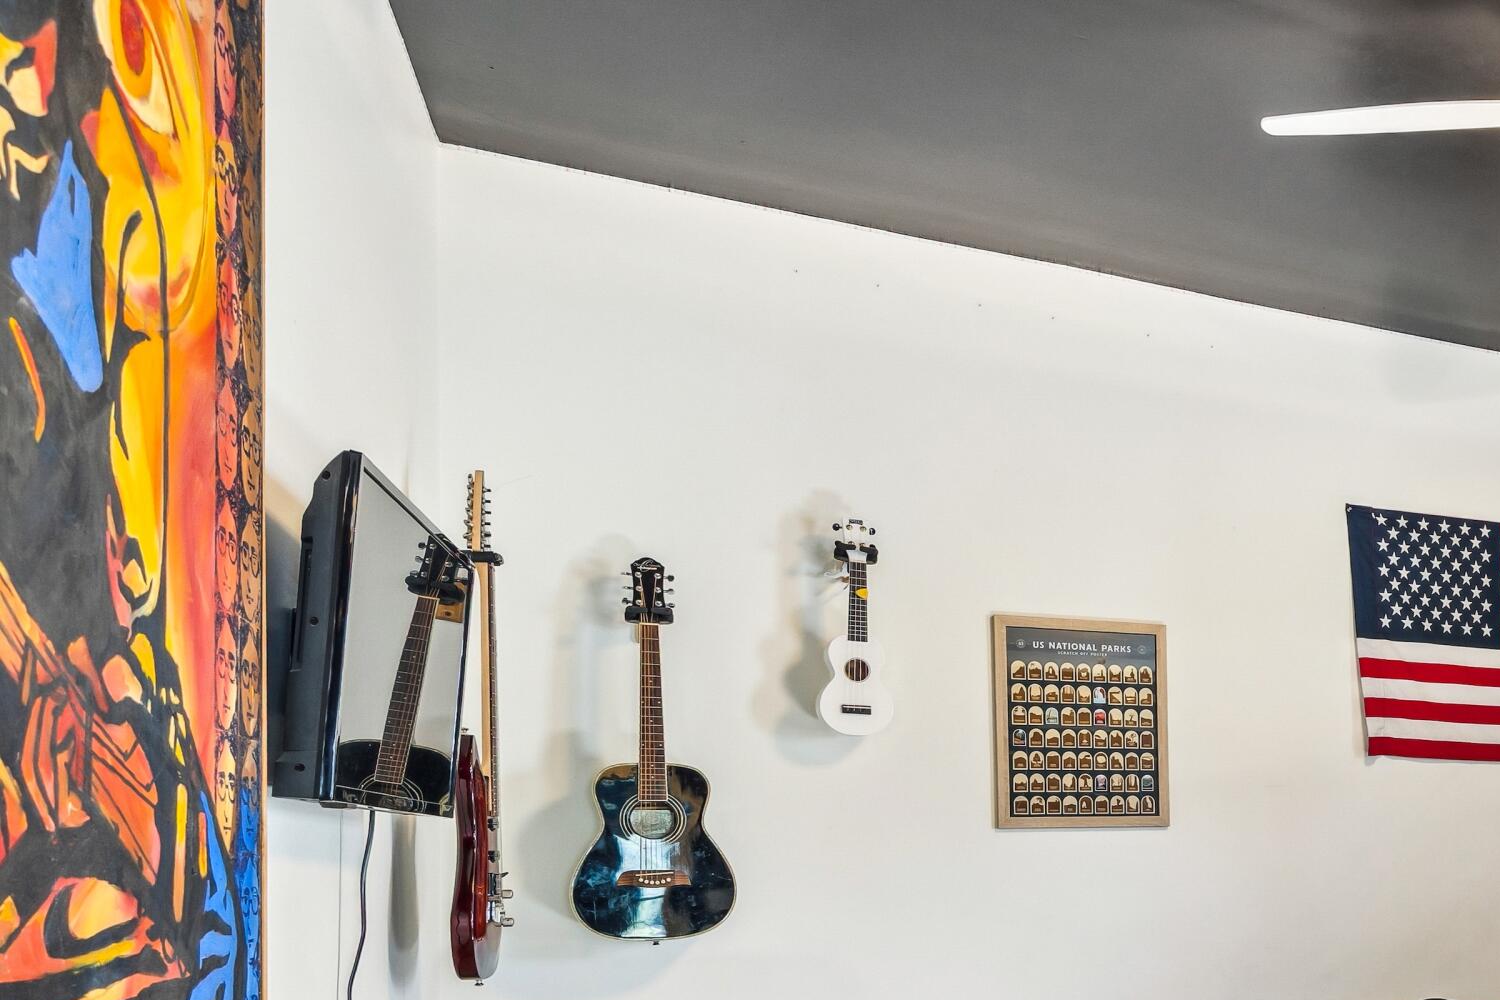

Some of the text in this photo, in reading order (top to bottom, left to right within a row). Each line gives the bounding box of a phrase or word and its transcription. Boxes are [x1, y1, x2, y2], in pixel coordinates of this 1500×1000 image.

[1032, 641, 1045, 649] US
[1048, 641, 1098, 652] NATIONAL
[1101, 644, 1132, 653] PARKS
